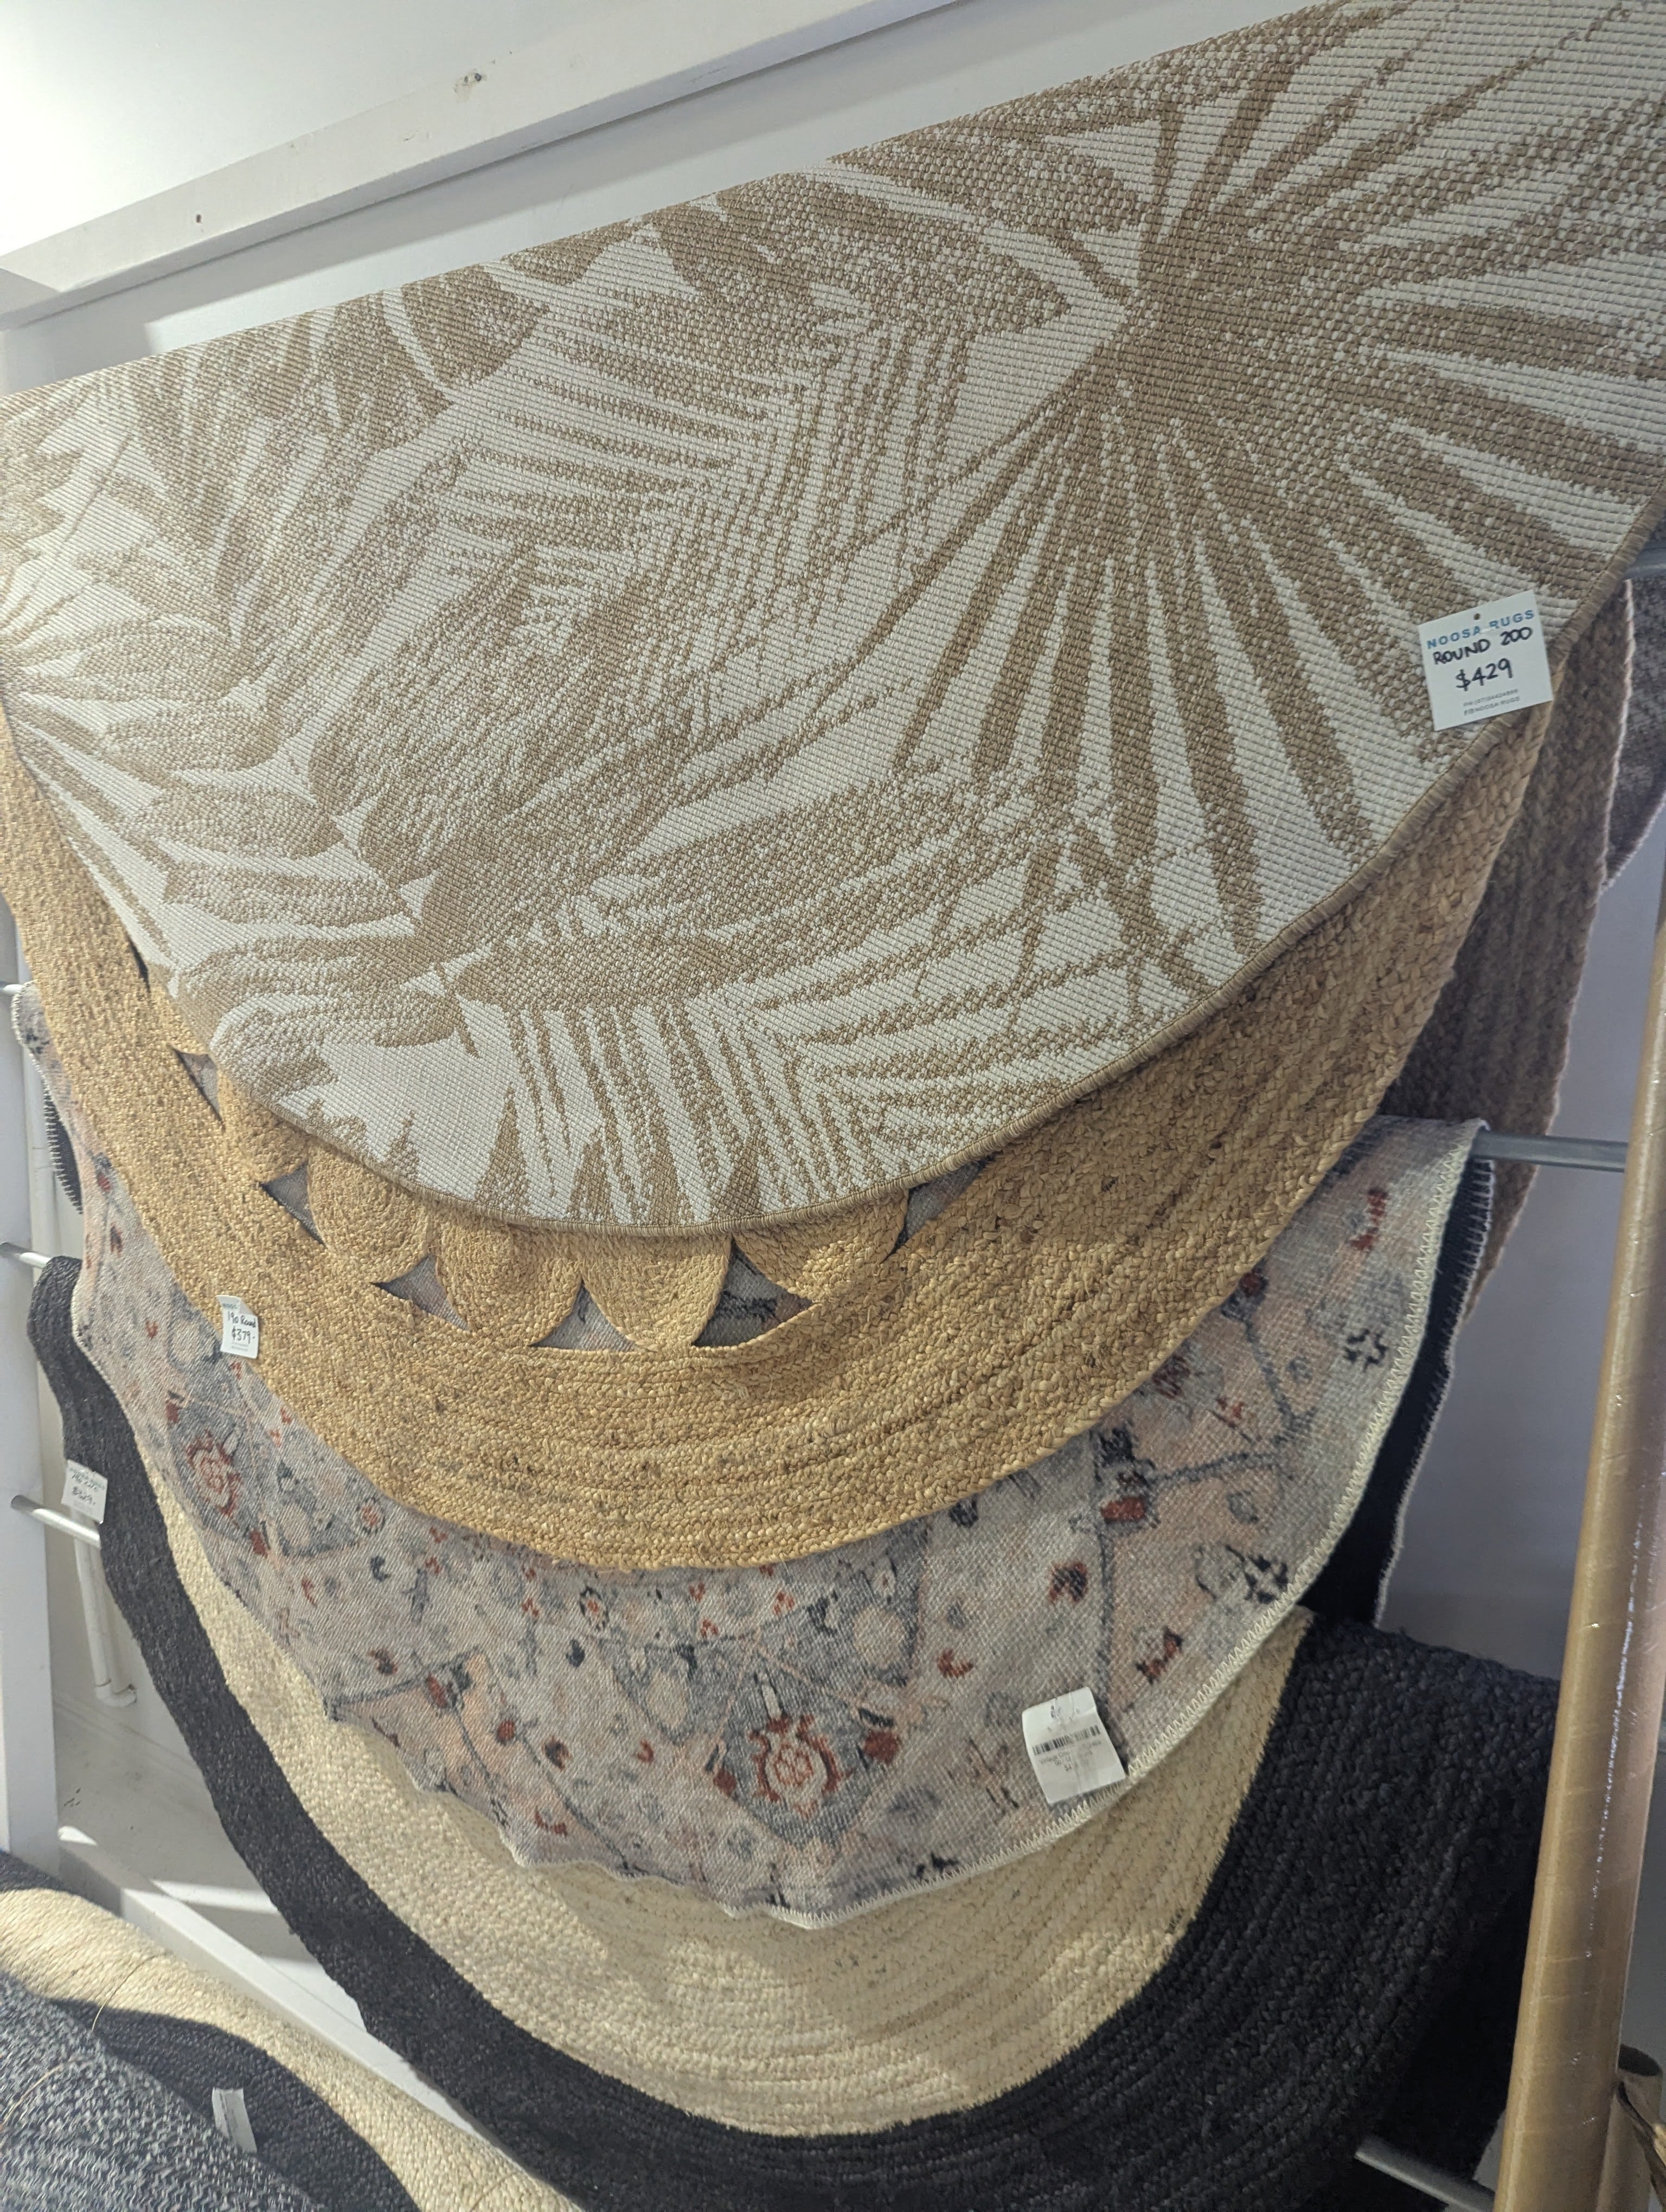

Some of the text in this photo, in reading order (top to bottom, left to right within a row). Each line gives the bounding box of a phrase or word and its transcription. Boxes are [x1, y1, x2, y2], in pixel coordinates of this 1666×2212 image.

[1427, 609, 1535, 650] NOOSA RUGS
[1433, 627, 1533, 665] ROUND 200
[1456, 658, 1513, 691] $429
